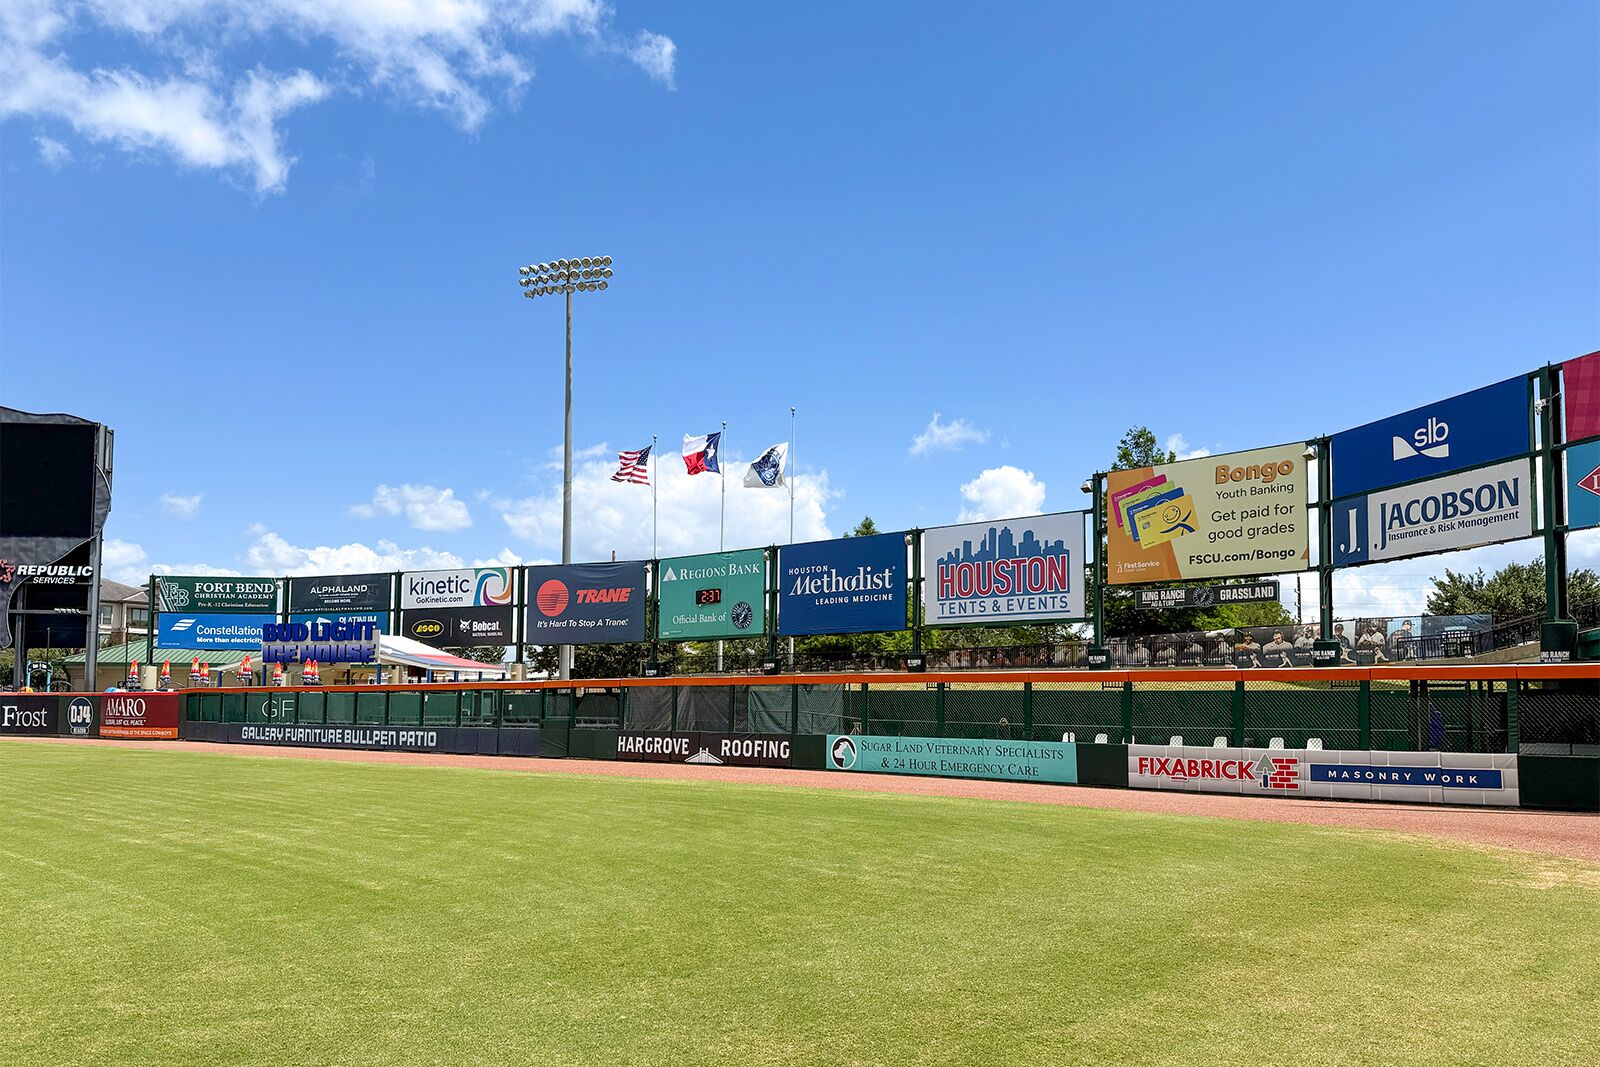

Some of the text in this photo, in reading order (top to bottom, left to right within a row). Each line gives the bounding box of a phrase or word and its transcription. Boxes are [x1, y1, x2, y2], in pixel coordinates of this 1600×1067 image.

[1414, 417, 1449, 447] slb
[1215, 460, 1294, 484] Bongo
[1216, 483, 1294, 500] Youth Banking
[1211, 503, 1295, 525] Get paid for
[1374, 477, 1519, 550] JACOBSON
[1208, 522, 1295, 543] good grades
[1388, 510, 1519, 541] Insurance & Risk Management
[1189, 548, 1295, 566] FSCU.com/Bongo
[17, 564, 93, 577] REPUBLIC
[680, 563, 760, 580] REGIONS BANK
[788, 565, 828, 575] HOUSTON
[938, 554, 1067, 600] HOUSTON
[33, 576, 75, 584] SERVICES
[194, 582, 275, 593] FORT BEND
[310, 584, 368, 594] ALPHALAND
[410, 575, 470, 595] kinetic
[789, 566, 893, 596] Methodist
[416, 596, 463, 604] GoKinetic.com
[576, 588, 631, 604] TRANE
[701, 589, 720, 602] 2:37
[815, 593, 893, 606] LEADING MEDICINE
[1142, 591, 1158, 601] KING
[1161, 589, 1185, 600] RANCH
[1220, 586, 1274, 600] GRASSLAND
[939, 595, 1068, 615] TENTS & EVENTS
[537, 620, 548, 628] It's
[549, 620, 567, 628] Hard
[569, 619, 577, 627] To
[578, 619, 595, 628] Stop
[596, 619, 603, 627] A
[673, 612, 727, 625] Official Bank of
[197, 625, 263, 636] Constellation
[262, 623, 376, 642] BUD LIGHT
[416, 625, 440, 633] ASCO
[233, 637, 263, 645] electricity
[263, 645, 376, 663] ICE HOUSE
[70, 705, 91, 723] DJ4
[106, 697, 146, 716] AMARO
[1, 706, 47, 727] Frost
[241, 727, 437, 747] GALLERY FURNITURE BULLPEN PATIO
[617, 736, 790, 759] HARGROVE ROOFING
[861, 740, 1064, 760] SUGAR LAND VETERINARY SPECIALISTS
[880, 758, 1039, 776] & 24 HOUR EMERGENCY CARE
[1138, 757, 1256, 781] FIXABRICK
[1328, 770, 1479, 785] MASONRY WORK
